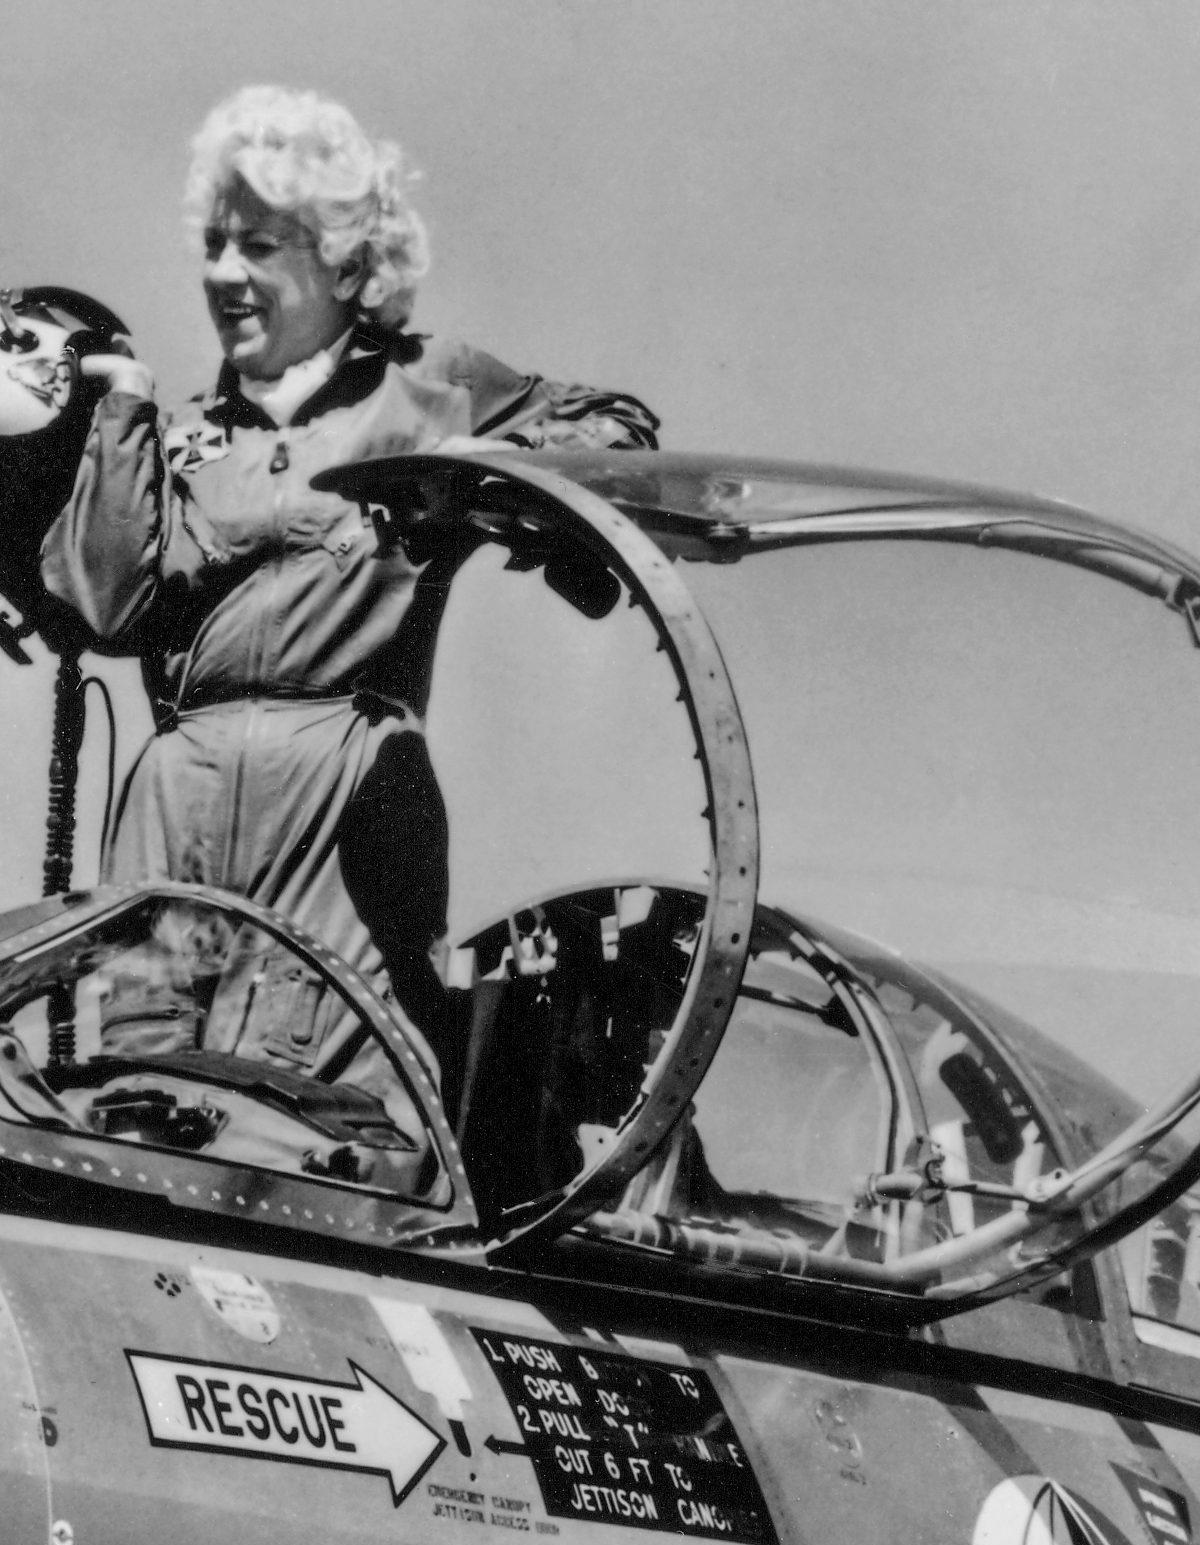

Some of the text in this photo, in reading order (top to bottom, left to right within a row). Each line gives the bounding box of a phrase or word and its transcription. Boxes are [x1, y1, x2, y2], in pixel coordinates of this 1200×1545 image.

[503, 1341, 562, 1373] PUSH
[670, 1372, 699, 1398] TO
[523, 1374, 583, 1407] OPEN
[176, 1374, 357, 1453] RESCUE
[538, 1409, 591, 1441] PULL
[555, 1445, 692, 1491] OUT 6 FT TO
[571, 1483, 658, 1520] JETTISON
